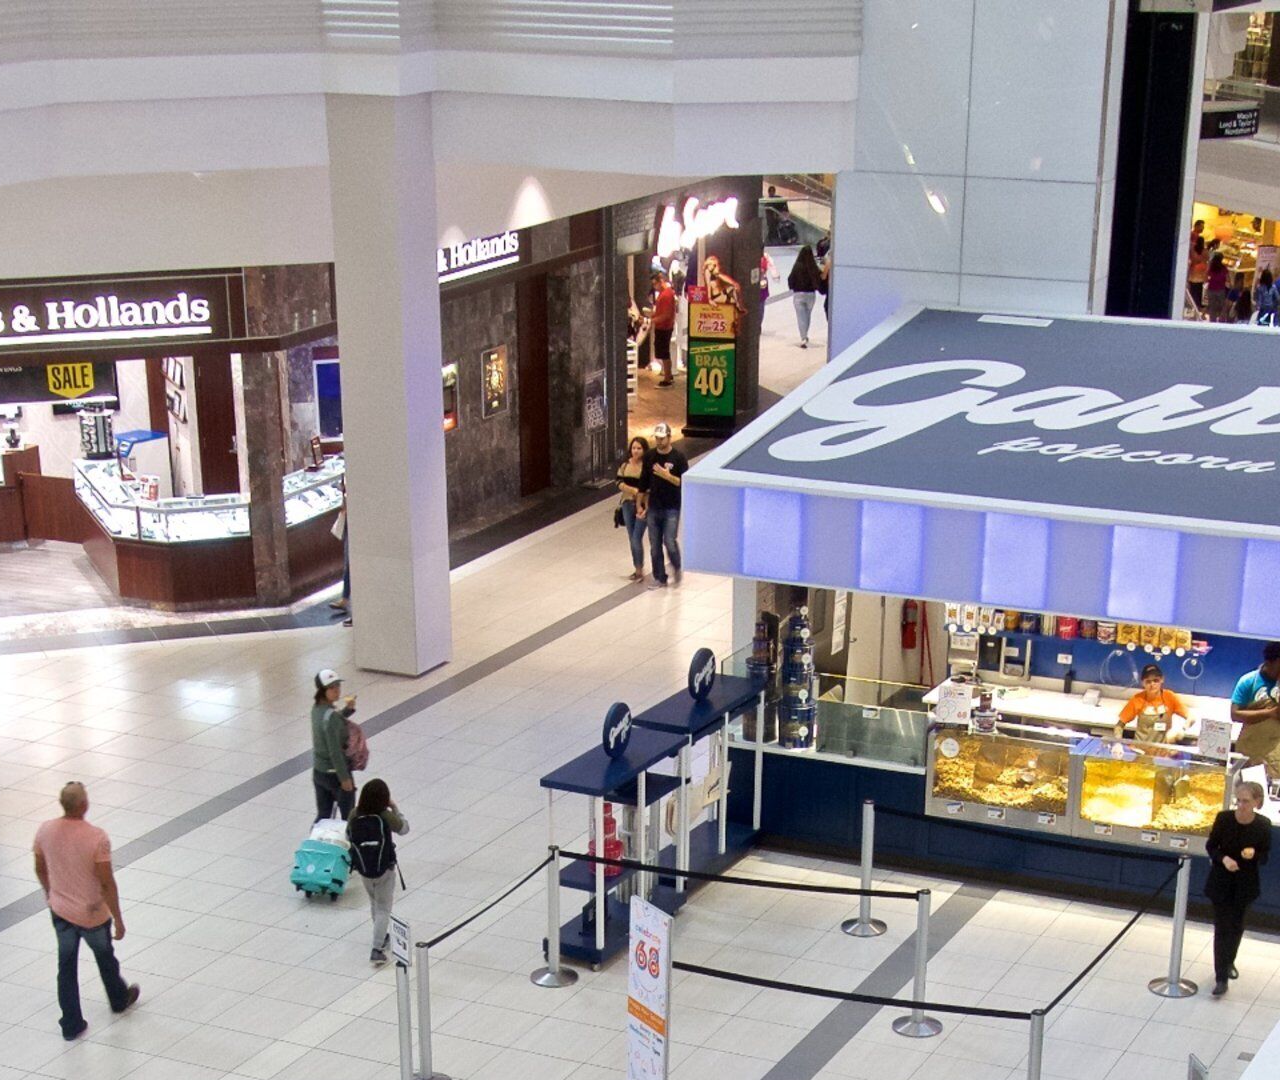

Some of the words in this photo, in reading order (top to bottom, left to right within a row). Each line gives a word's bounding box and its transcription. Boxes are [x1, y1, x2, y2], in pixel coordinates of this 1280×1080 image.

[450, 230, 520, 269] Hollands
[11, 304, 41, 332] &
[45, 292, 211, 330] Hollands
[51, 364, 90, 390] SALE
[695, 354, 728, 368] BRAS
[977, 436, 1276, 473] popcorn
[635, 939, 660, 979] 68
